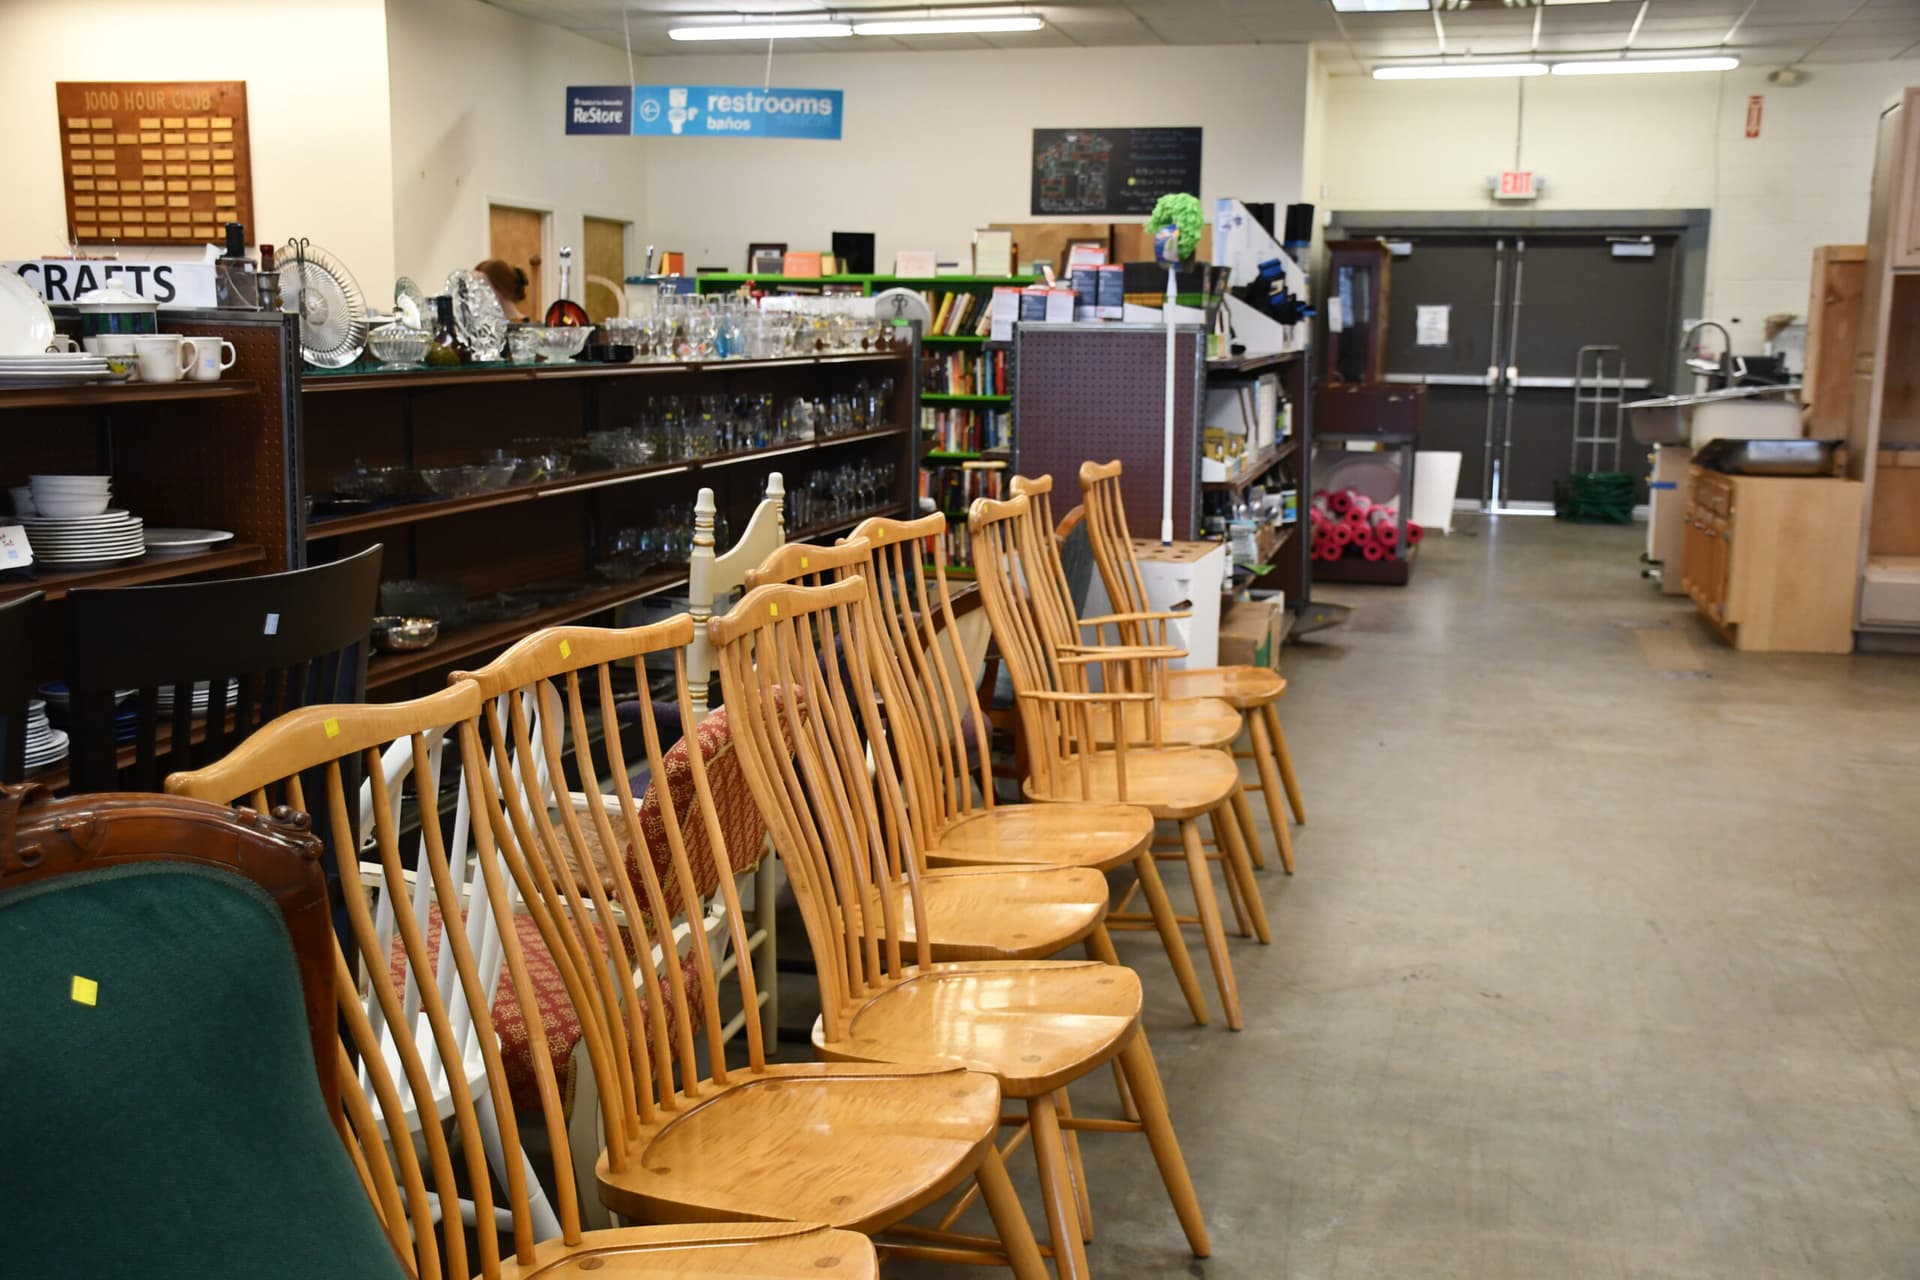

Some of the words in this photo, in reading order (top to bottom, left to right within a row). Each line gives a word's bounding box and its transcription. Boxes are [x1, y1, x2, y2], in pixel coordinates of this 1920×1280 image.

[84, 91, 119, 111] 1000
[125, 91, 167, 111] HOUR
[171, 91, 212, 112] CLUB
[707, 91, 833, 116] restrooms
[573, 106, 624, 124] ReStore
[706, 115, 752, 131] baños
[1501, 172, 1533, 195] EXIT
